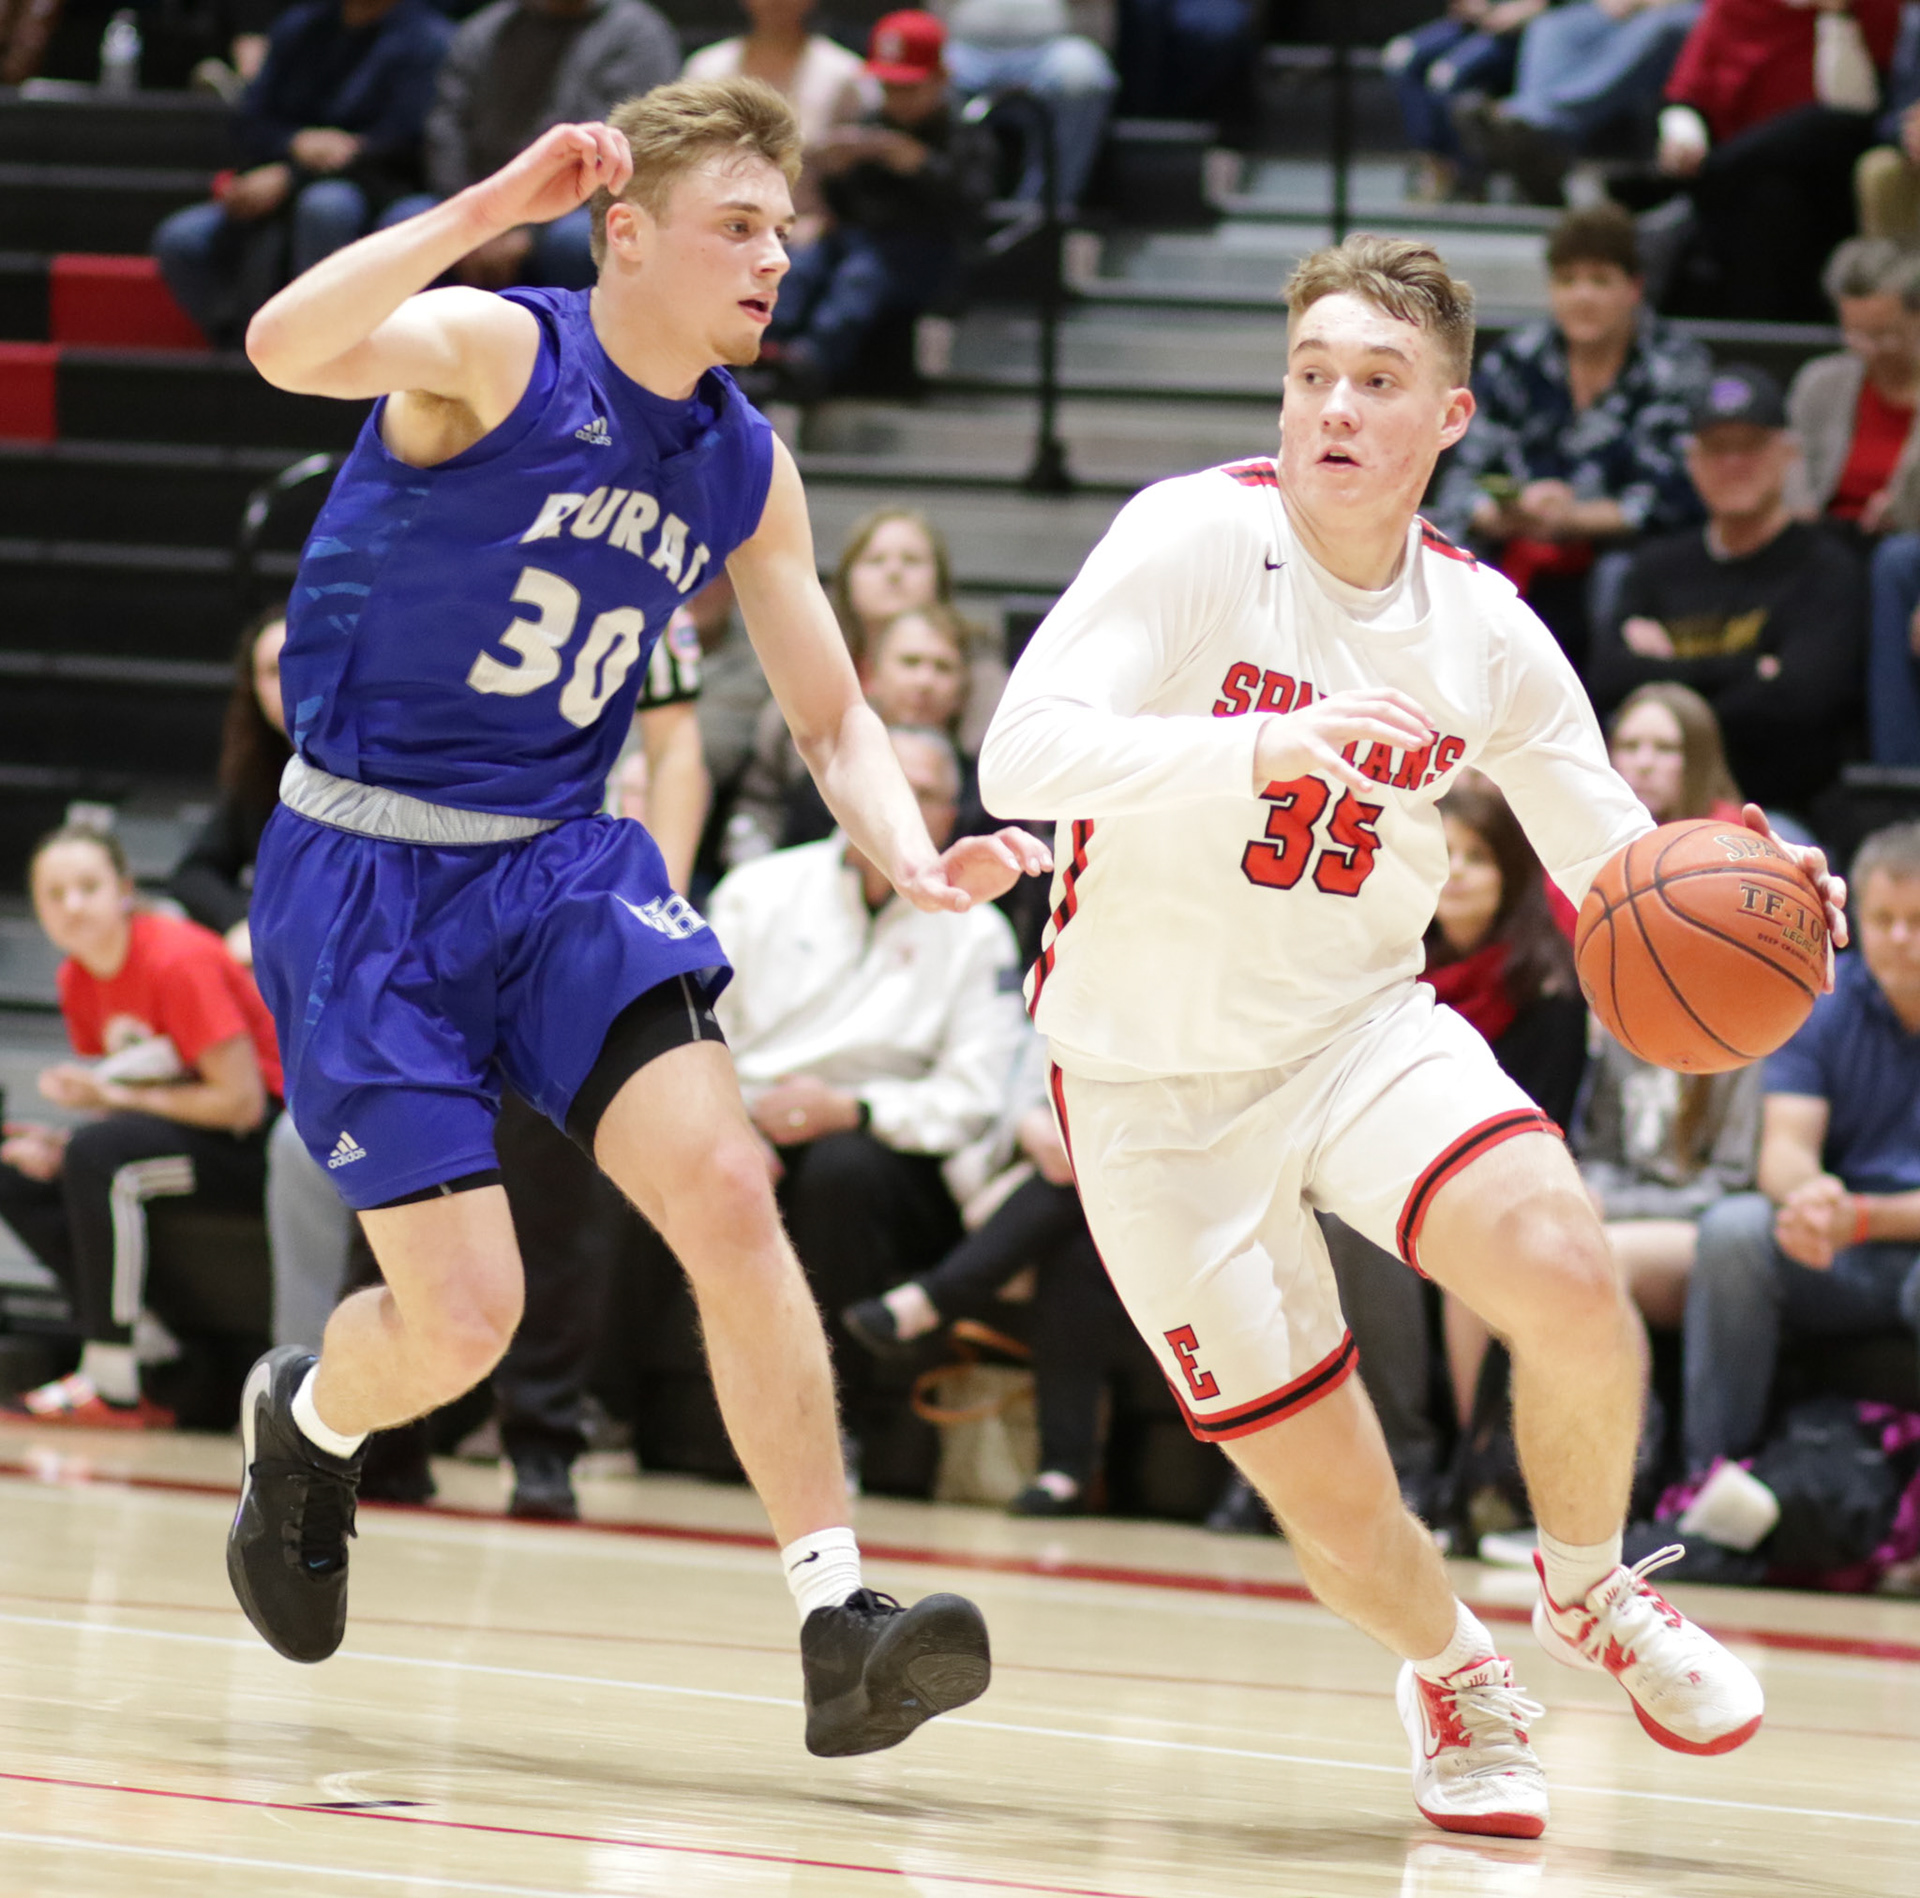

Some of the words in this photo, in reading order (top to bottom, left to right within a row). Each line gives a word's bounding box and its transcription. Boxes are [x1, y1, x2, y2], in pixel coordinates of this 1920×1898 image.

[465, 566, 646, 730] 30
[1241, 774, 1385, 898] 35
[1163, 1323, 1221, 1401] E
